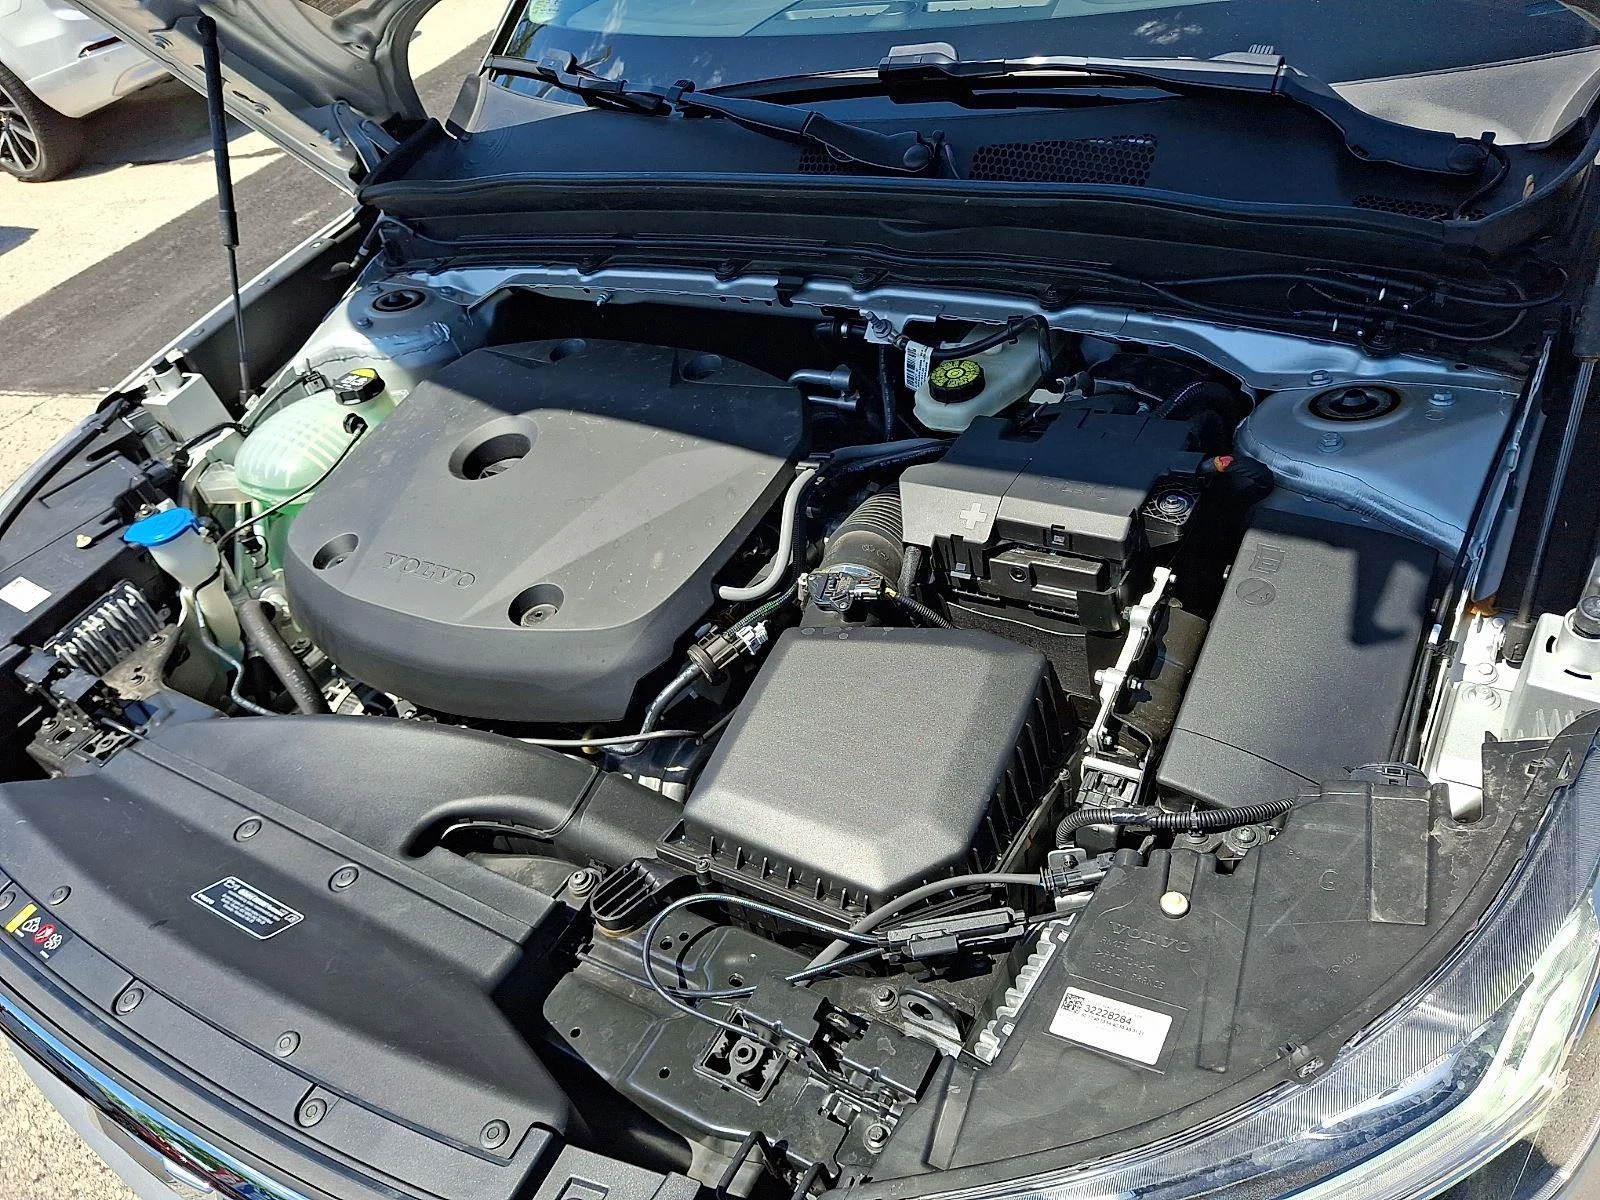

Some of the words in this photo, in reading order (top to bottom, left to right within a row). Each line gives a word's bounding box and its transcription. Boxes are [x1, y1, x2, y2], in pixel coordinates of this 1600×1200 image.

[382, 551, 477, 590] VOLVO
[1108, 920, 1192, 953] VOLVO
[1084, 1004, 1133, 1026] 32228284
